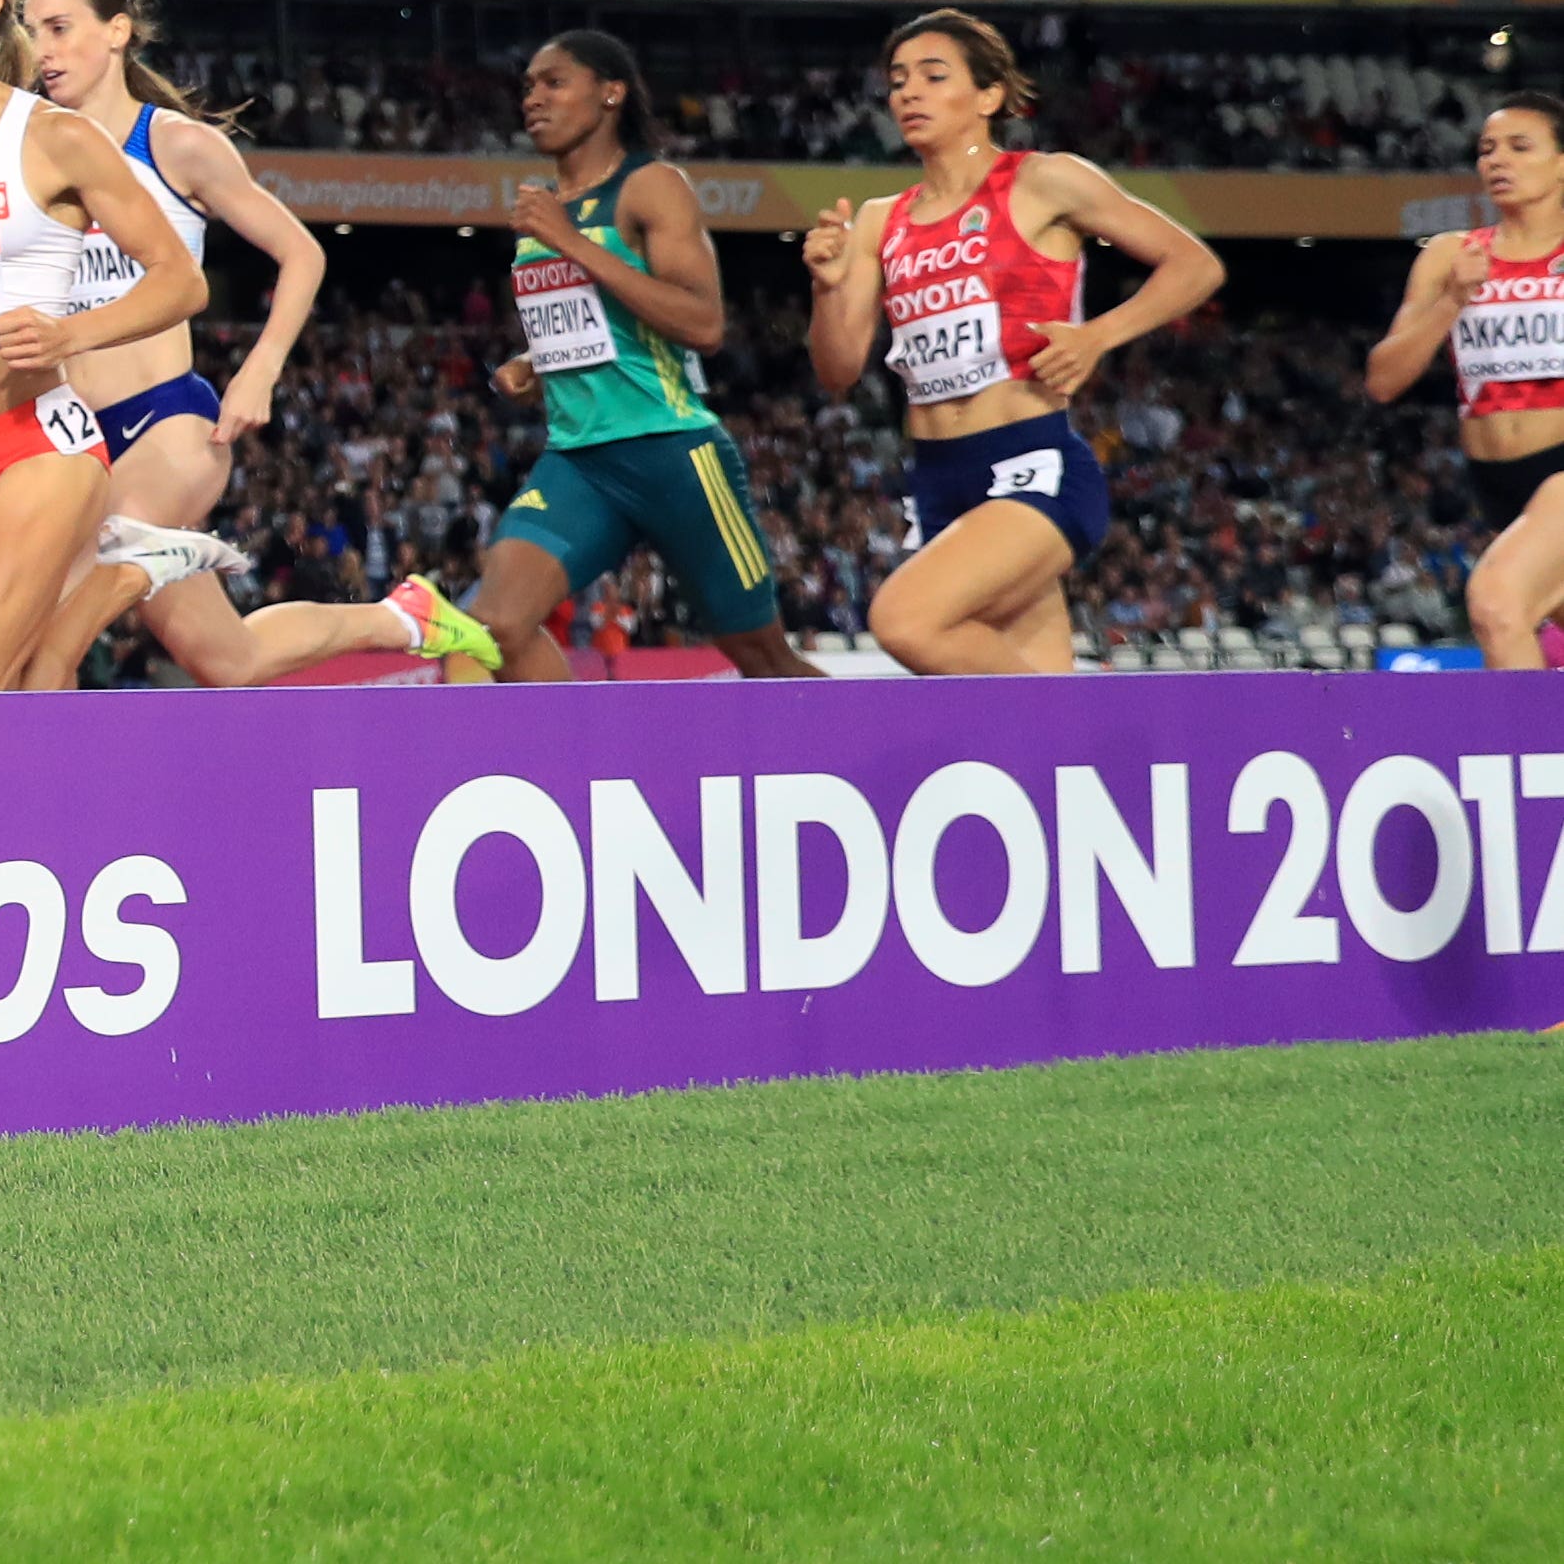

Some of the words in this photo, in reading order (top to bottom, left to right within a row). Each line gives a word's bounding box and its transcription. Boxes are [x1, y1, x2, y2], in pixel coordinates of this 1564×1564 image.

[513, 262, 587, 293] TOYOTA
[885, 275, 991, 321] OYOTA
[48, 400, 95, 446] 12
[310, 758, 1197, 1019] LONDON
